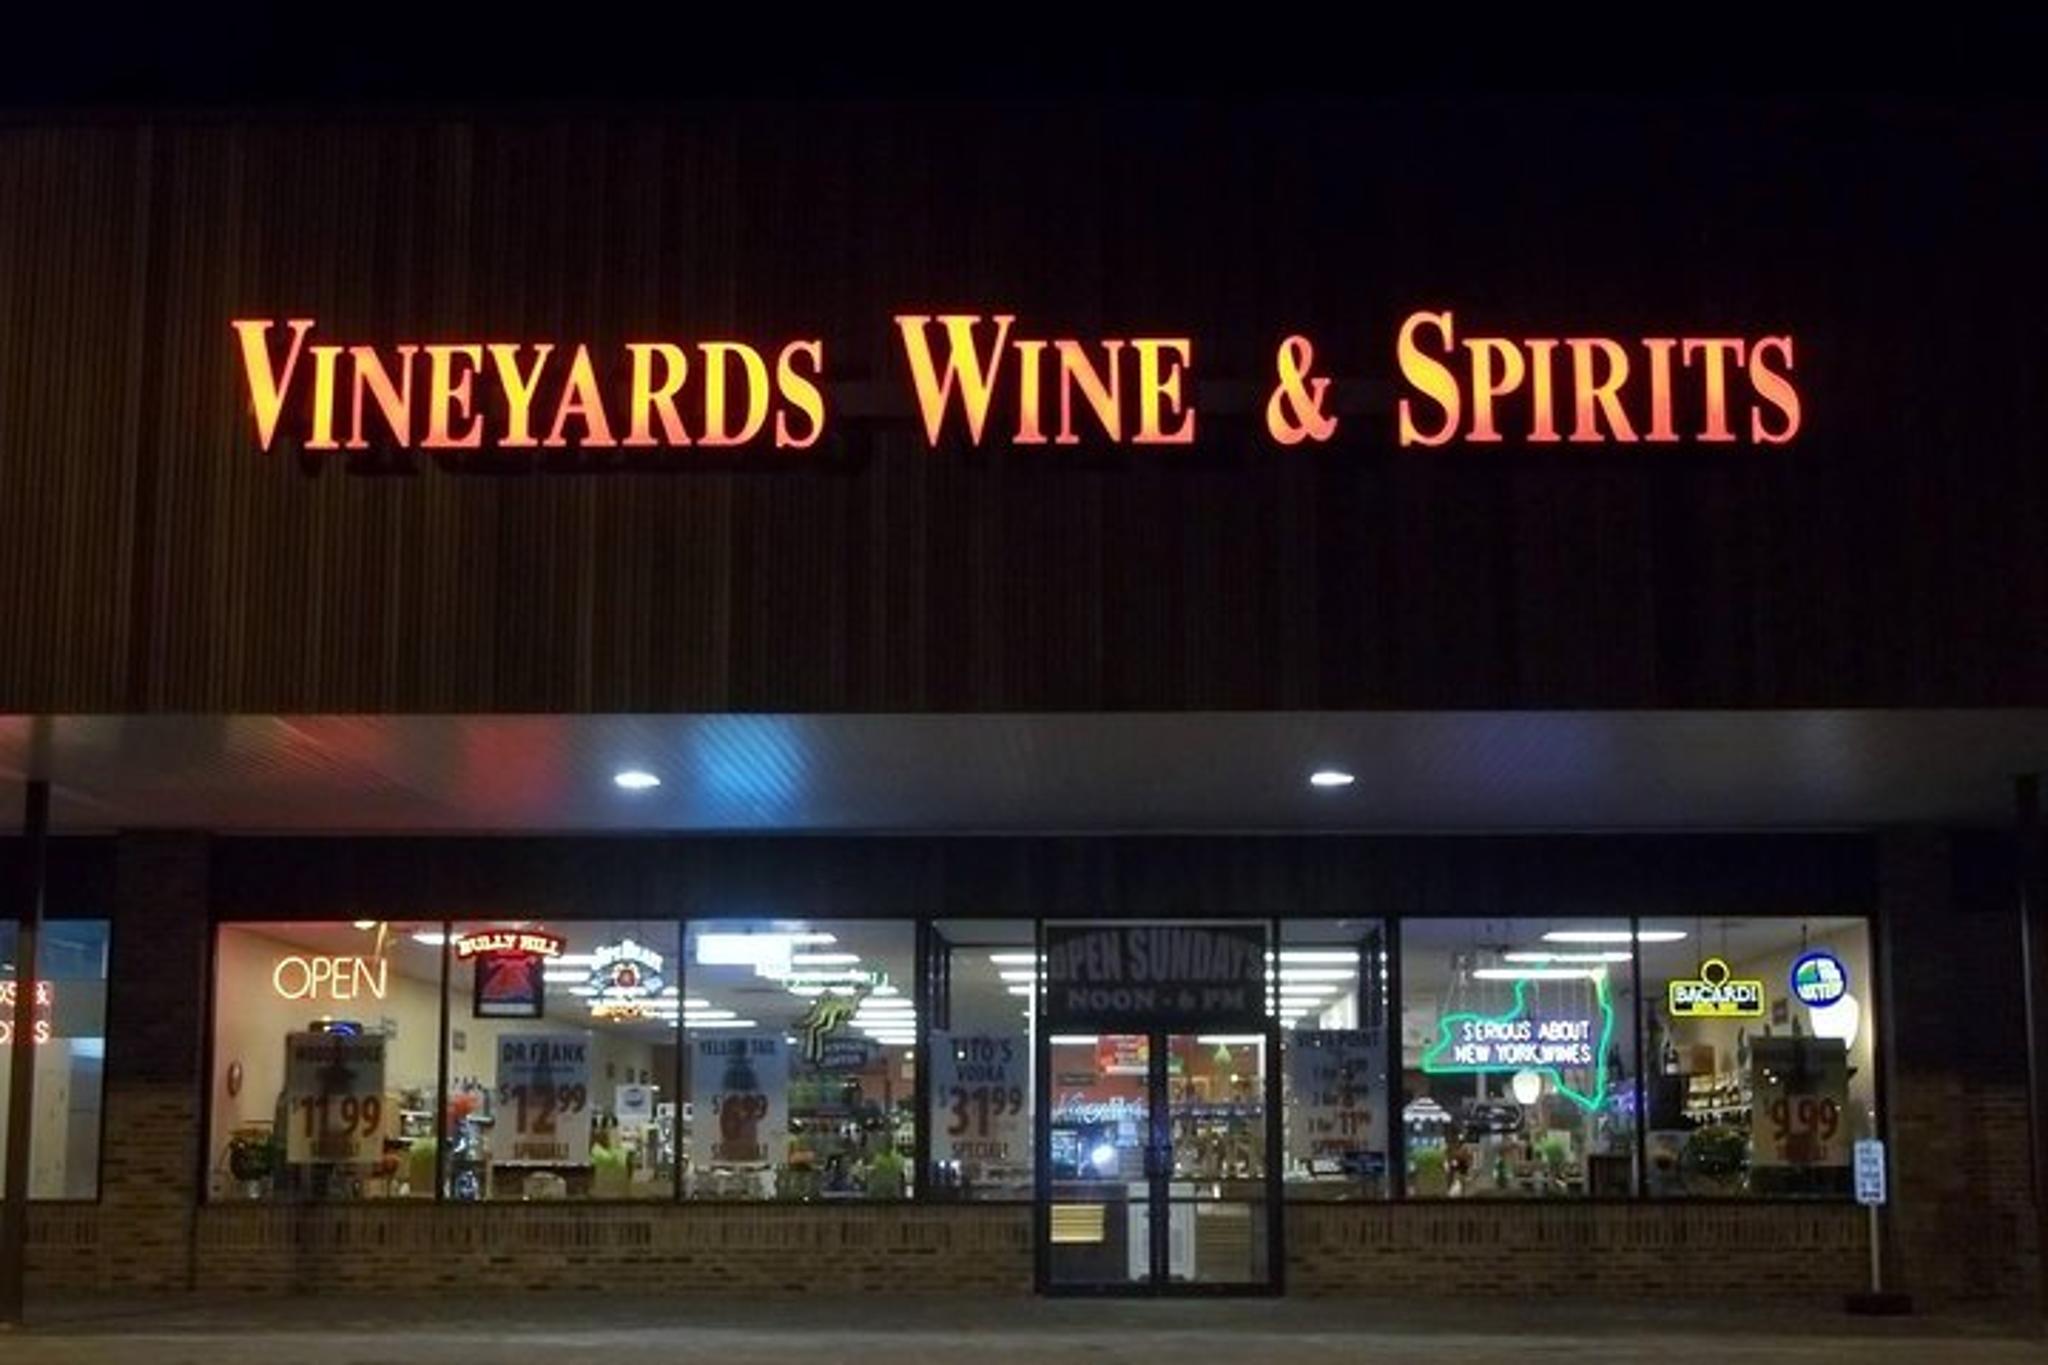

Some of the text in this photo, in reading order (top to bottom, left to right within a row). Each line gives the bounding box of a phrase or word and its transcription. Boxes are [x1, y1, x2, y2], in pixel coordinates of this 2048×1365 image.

[231, 310, 1801, 452] VINEYARDS WINE & SPIRITS
[458, 935, 560, 956] BULLY HILL
[1049, 931, 1122, 981] OPEN
[273, 956, 387, 999] OPEN
[1067, 988, 1155, 1011] NOON
[1675, 985, 1756, 1003] BACARDI
[1463, 1020, 1589, 1041] SERIOUS ABOUT
[1454, 1043, 1592, 1063] NEW YORK WINES
